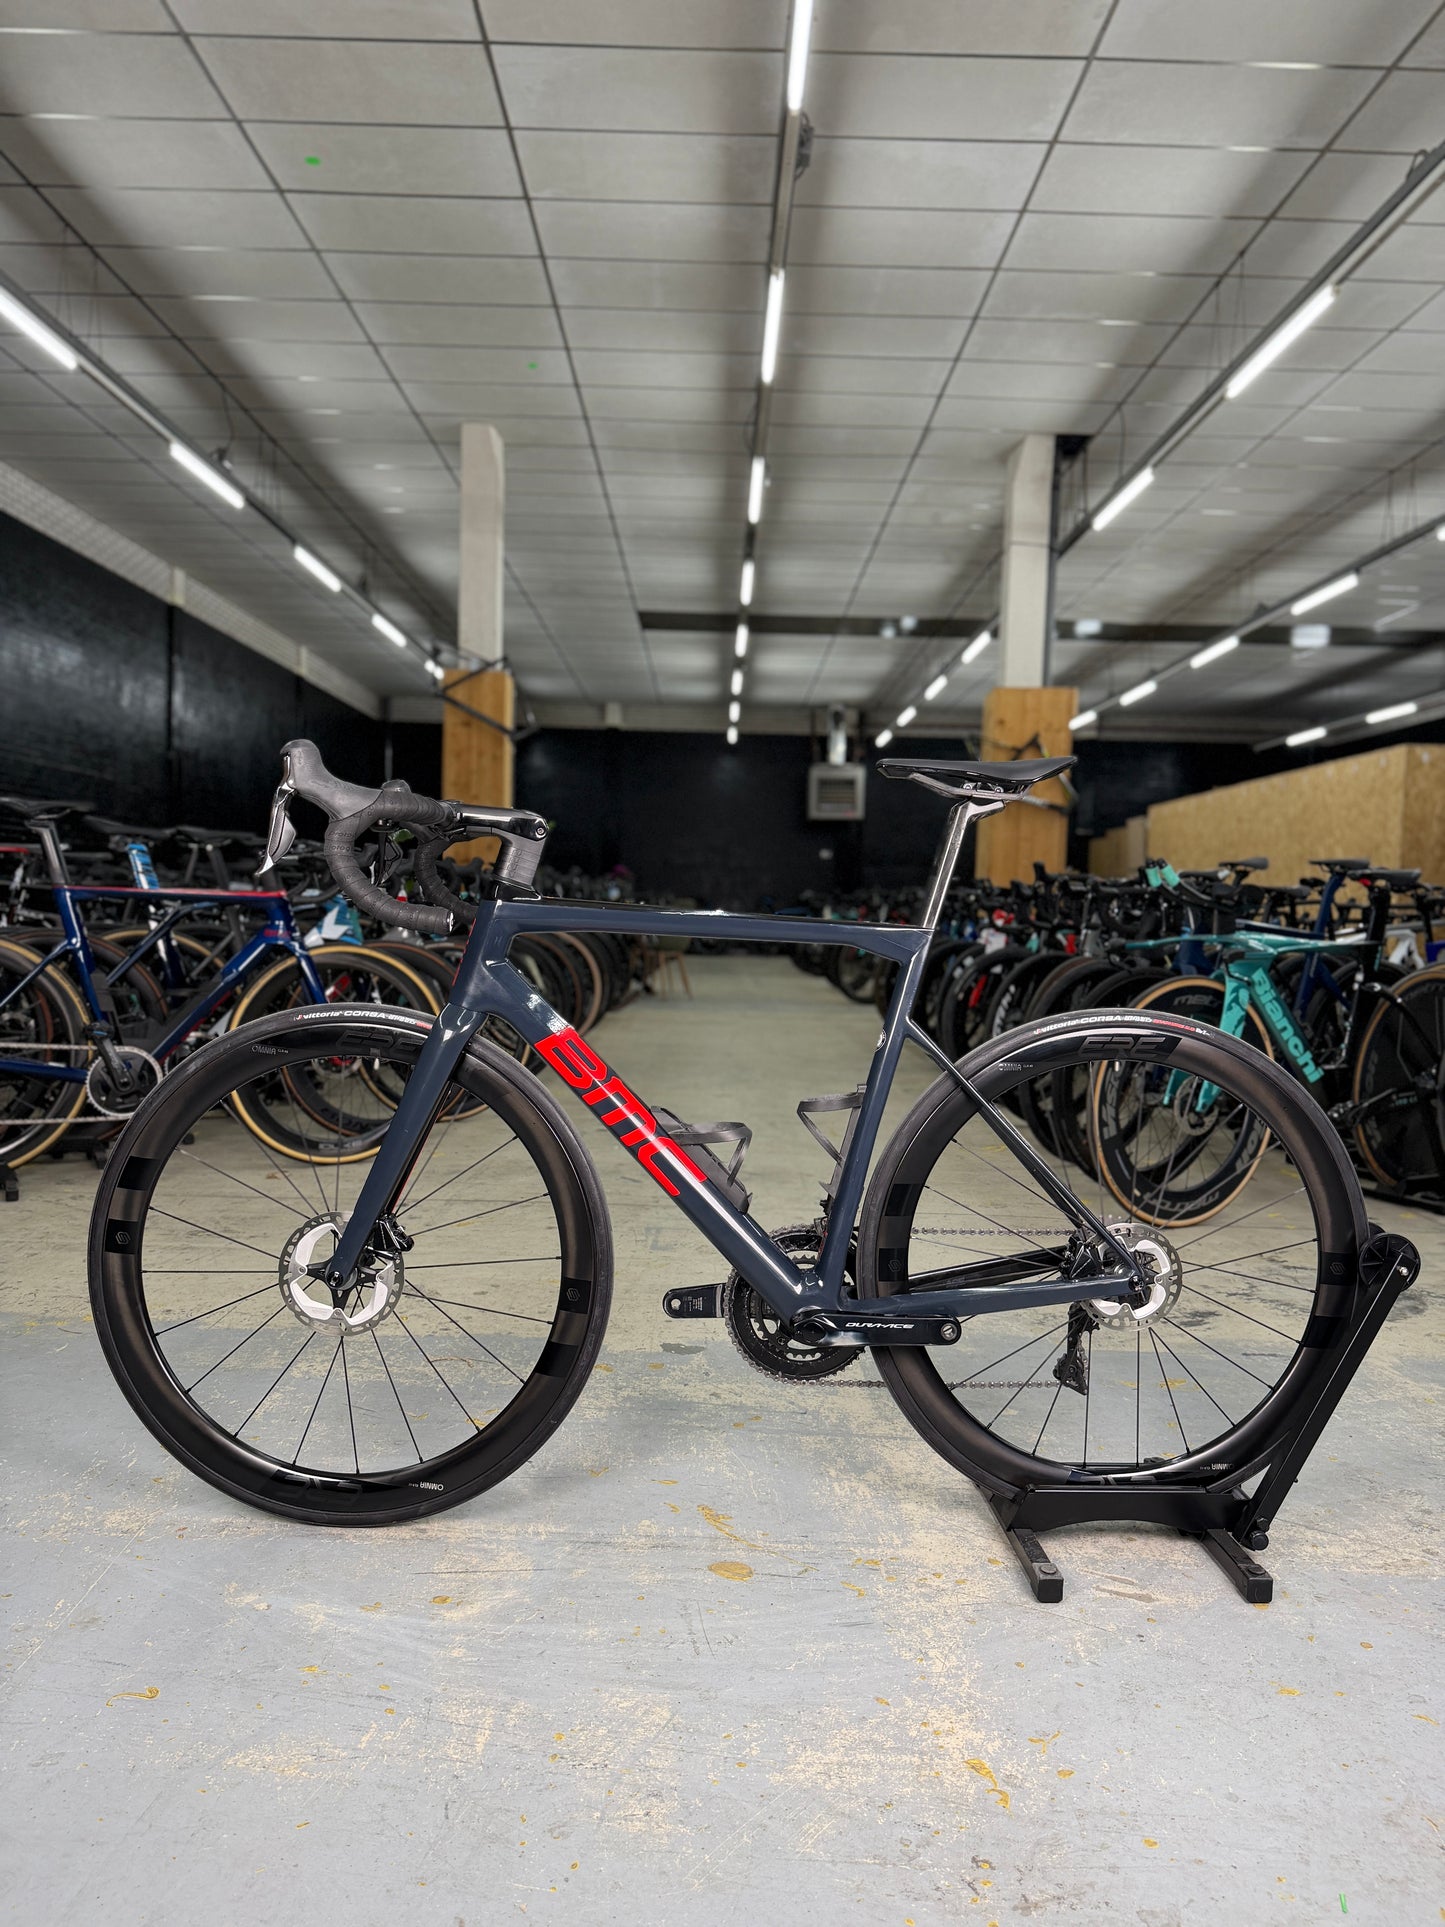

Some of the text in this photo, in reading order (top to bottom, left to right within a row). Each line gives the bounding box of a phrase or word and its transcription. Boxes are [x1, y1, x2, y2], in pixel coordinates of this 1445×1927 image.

[1172, 994, 1222, 1008] metr
[302, 1010, 386, 1020] vittoria CORSA
[1041, 1019, 1078, 1032] vittoria
[1080, 1015, 1122, 1024] CORSA
[1251, 967, 1325, 1084] Bianchi
[1077, 1036, 1166, 1057] ERE
[534, 1025, 708, 1197] BMC
[845, 1321, 915, 1330] DURA-ACE
[419, 1481, 444, 1491] OMNIA
